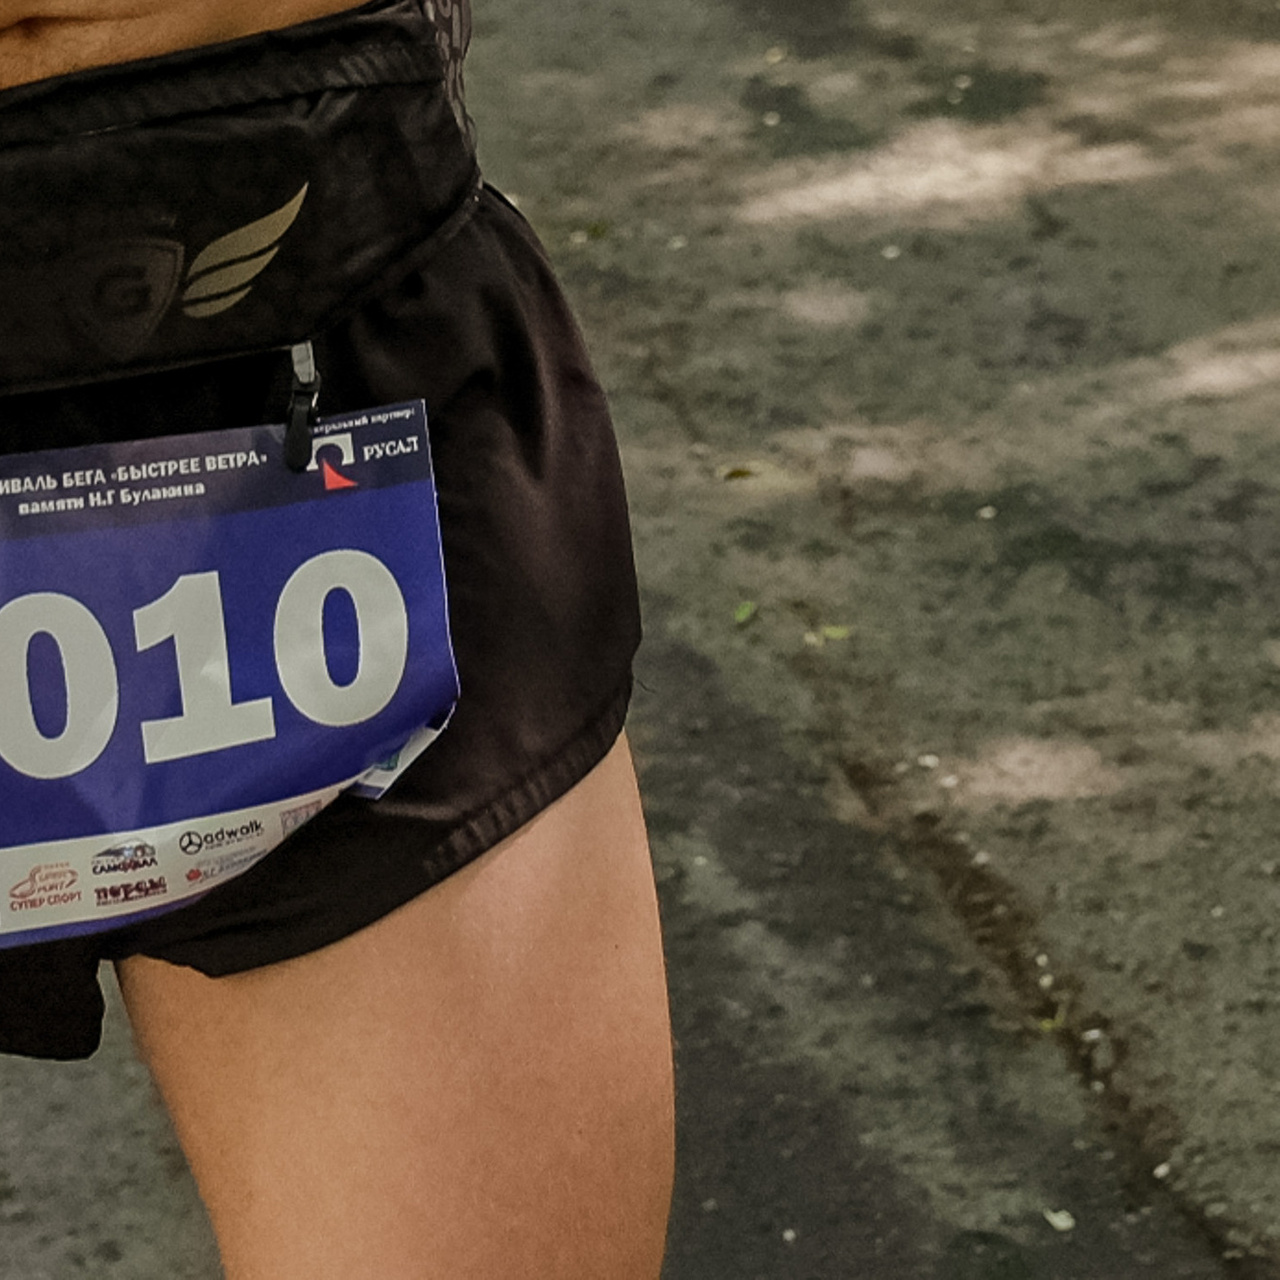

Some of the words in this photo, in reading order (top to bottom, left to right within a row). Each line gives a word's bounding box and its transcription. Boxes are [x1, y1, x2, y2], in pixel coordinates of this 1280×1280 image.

[363, 436, 419, 462] РУСАЛ
[62, 467, 107, 489] БЕГА
[110, 456, 201, 482] «БЫСТРЕЕ
[205, 449, 268, 473] ВЕТРА»
[18, 498, 85, 516] памяти
[120, 481, 206, 506] Булакина
[9, 896, 47, 912] СУПЕР
[47, 890, 83, 907] СПОРТ
